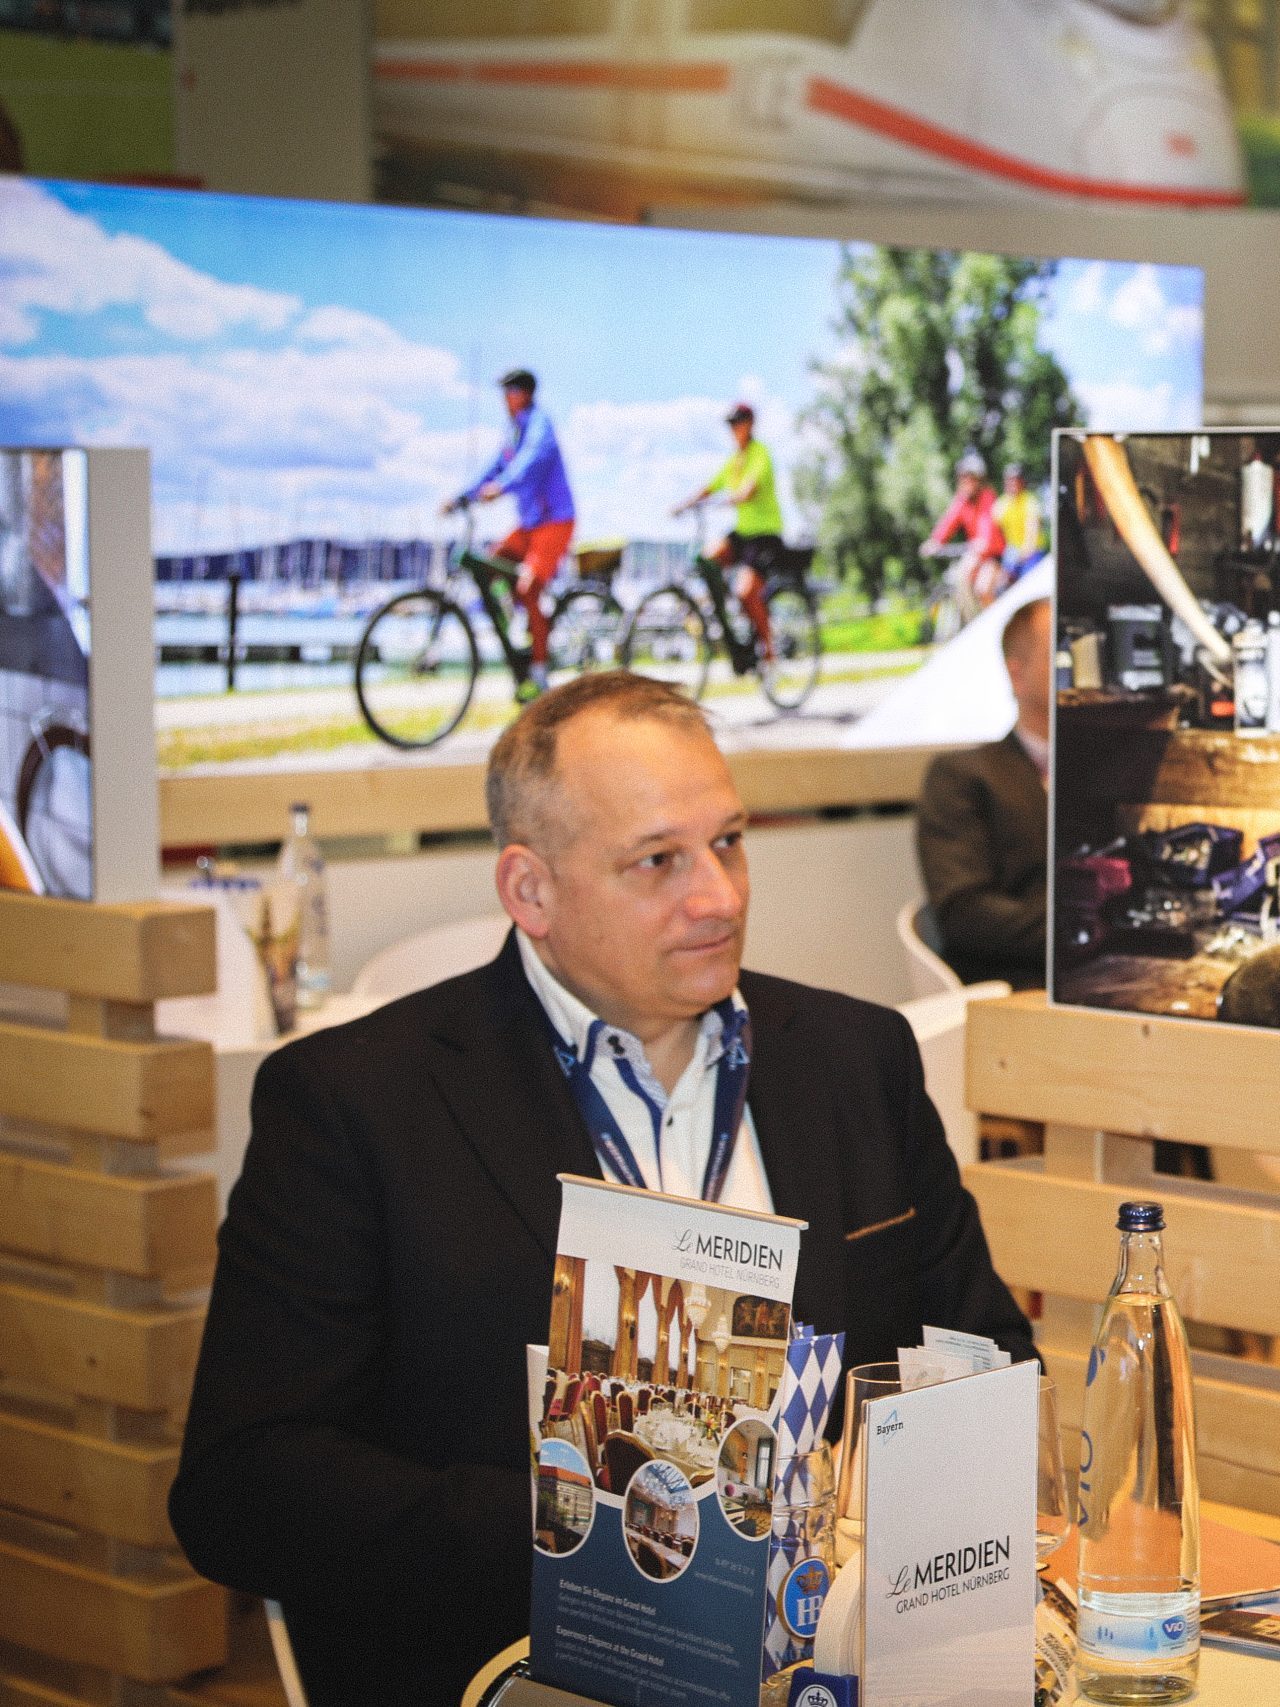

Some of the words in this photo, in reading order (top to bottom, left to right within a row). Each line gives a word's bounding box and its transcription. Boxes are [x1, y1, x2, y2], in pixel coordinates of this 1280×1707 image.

[695, 1234, 783, 1271] MERIDIEN
[680, 1256, 709, 1273] GRAND
[709, 1264, 734, 1280] HOTEL
[736, 1268, 780, 1289] NÜRNBERG
[876, 1421, 904, 1436] Bayern
[886, 1565, 912, 1599] Le
[914, 1535, 1010, 1590] MERIDIEN
[896, 1593, 929, 1614] GRAND
[931, 1583, 961, 1603] HOTEL
[962, 1567, 1010, 1594] NÜRNBERG
